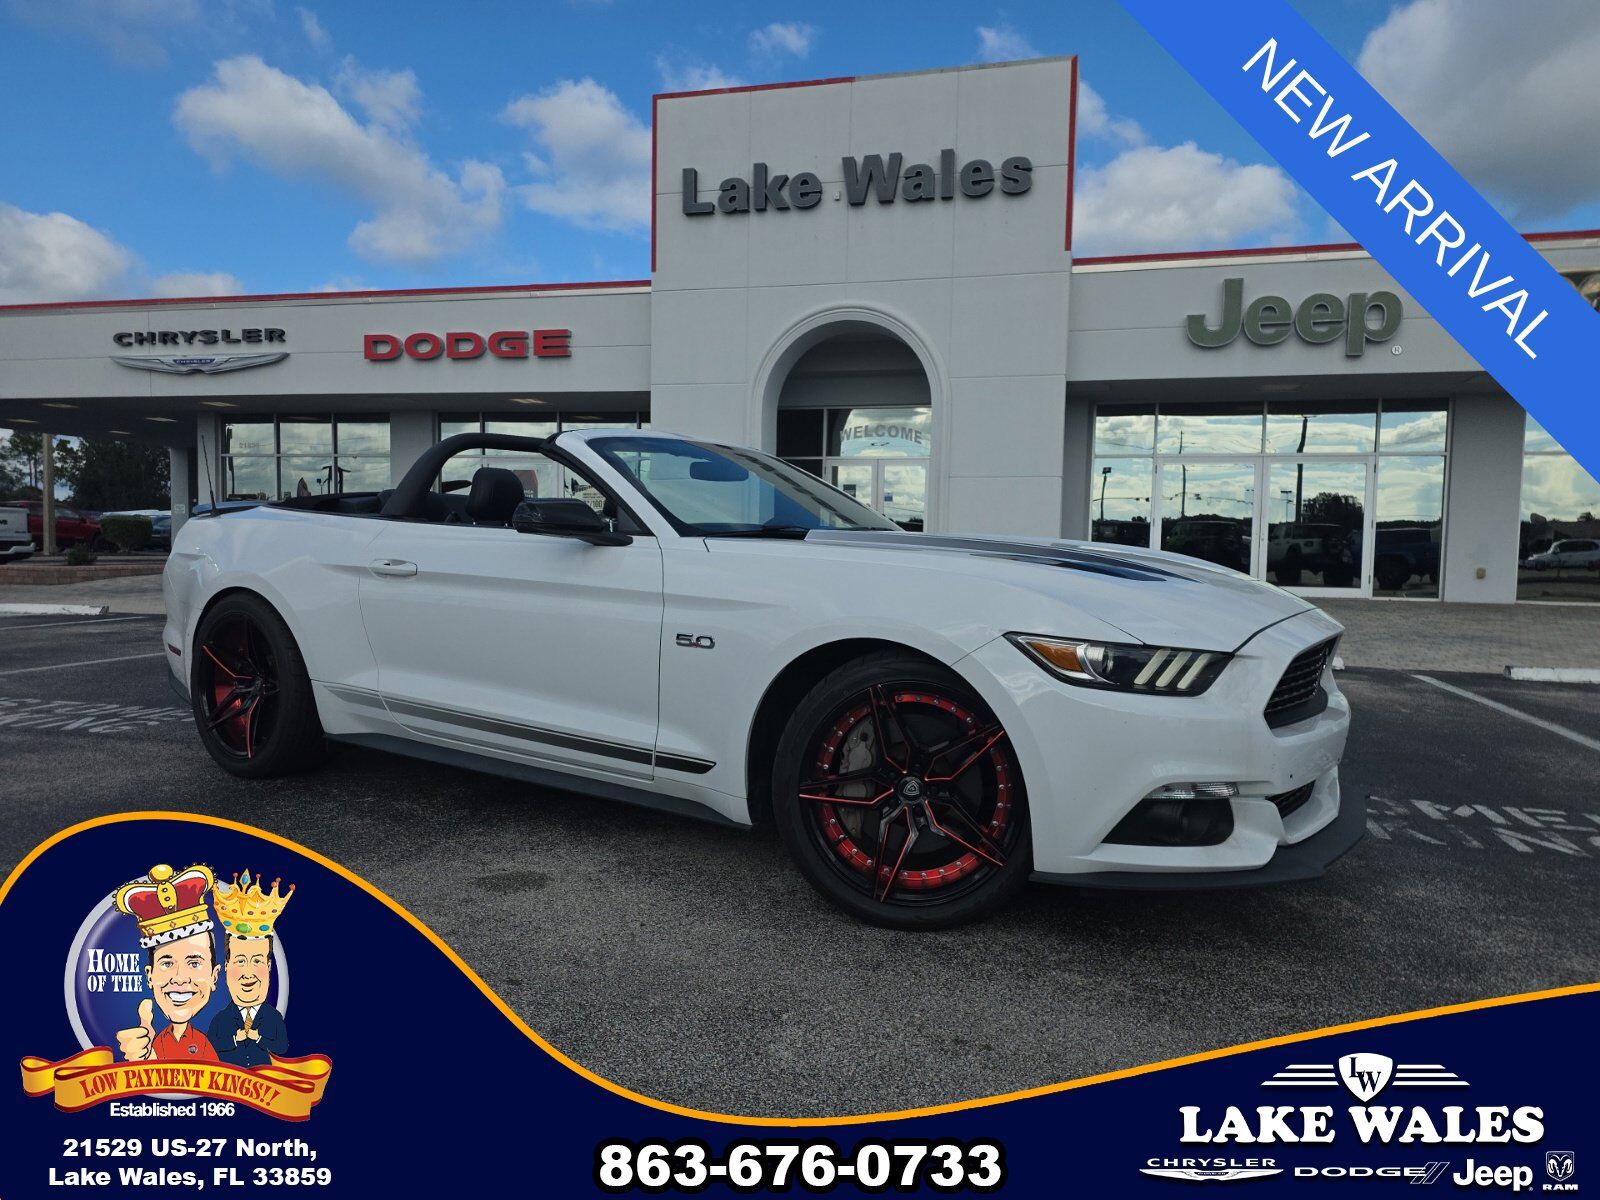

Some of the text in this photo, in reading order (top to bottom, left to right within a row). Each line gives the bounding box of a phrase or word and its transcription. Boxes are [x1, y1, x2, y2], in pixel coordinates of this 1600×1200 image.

[682, 148, 1033, 217] Lake Wales
[1186, 277, 1404, 358] Jeep
[112, 327, 287, 347] CHRYSLER
[364, 328, 572, 361] DODGE
[840, 424, 923, 444] WELCOME
